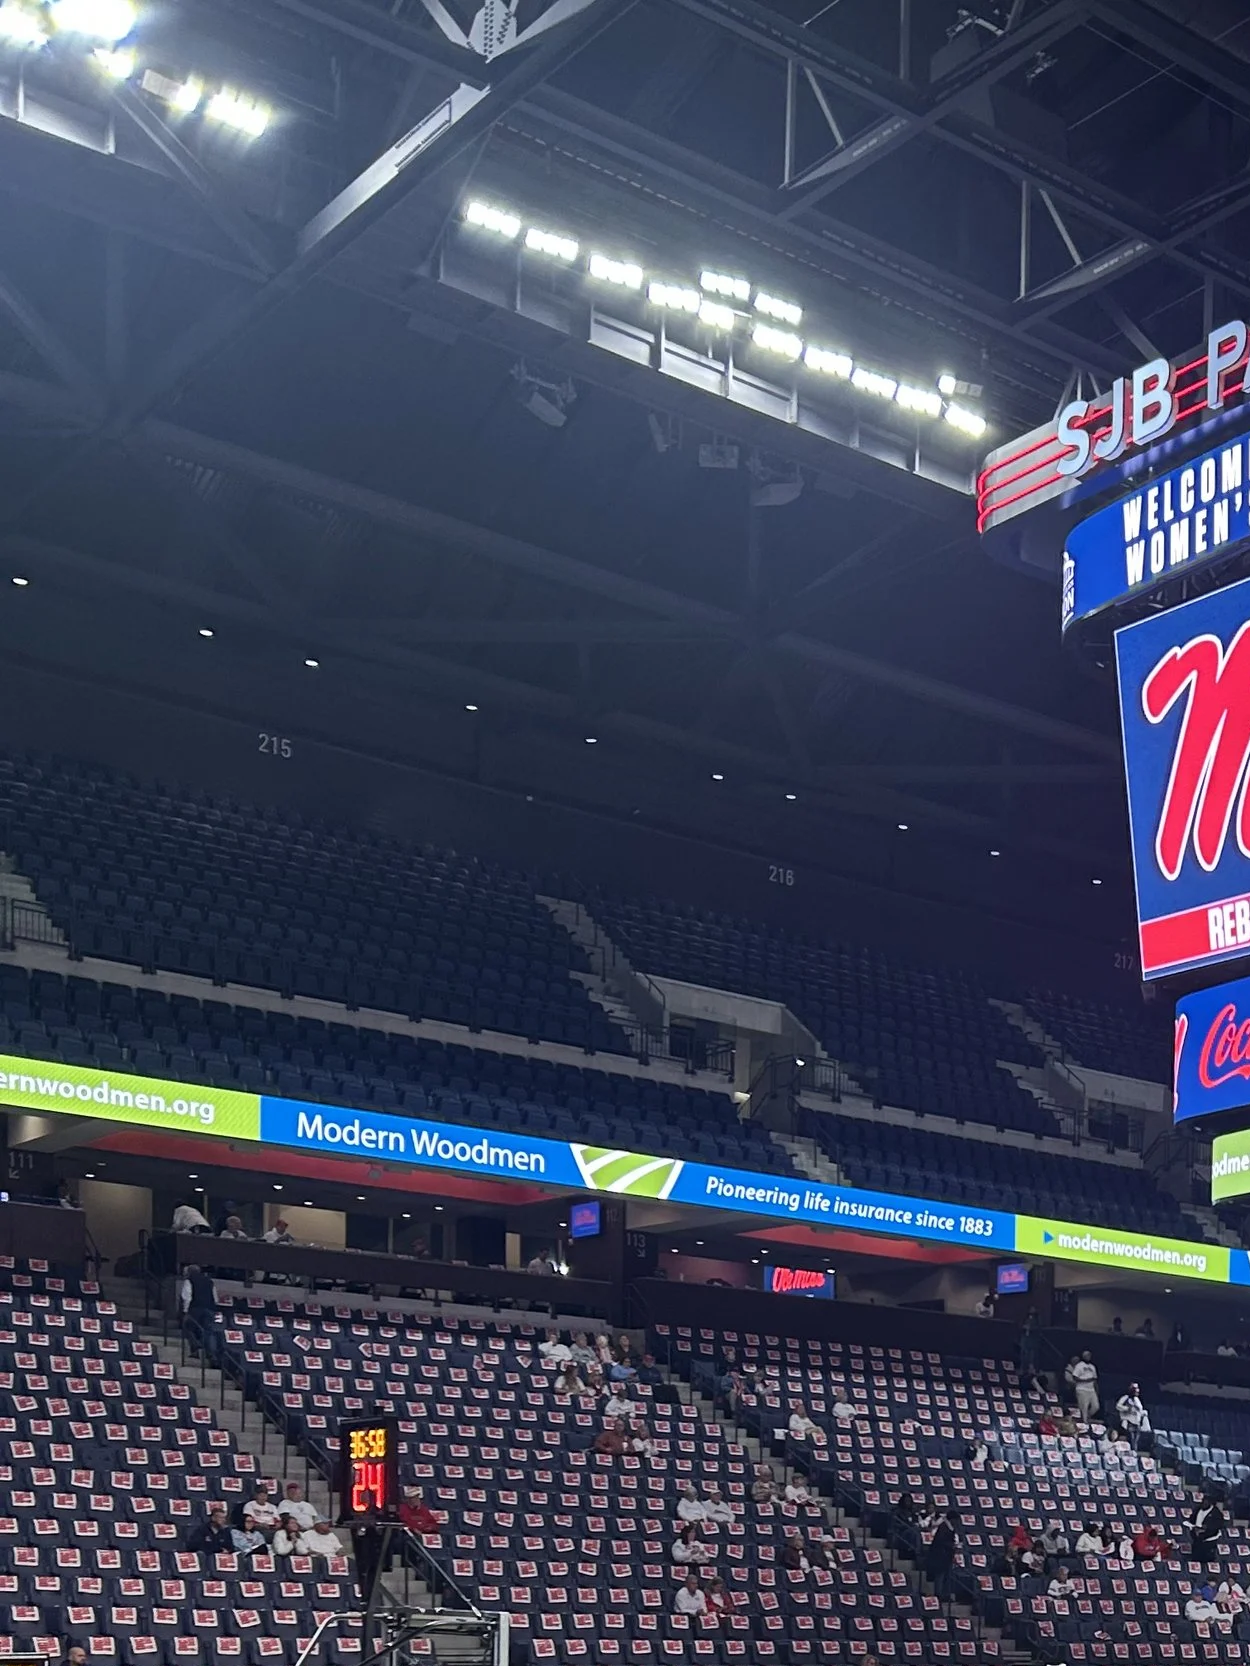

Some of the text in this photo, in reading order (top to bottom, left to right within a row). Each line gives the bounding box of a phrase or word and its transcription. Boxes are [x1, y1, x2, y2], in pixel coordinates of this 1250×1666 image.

[1056, 358, 1176, 476] SJB
[258, 733, 291, 758] 215
[297, 1111, 545, 1173] Modern Woodmen
[706, 1176, 993, 1236] Pioneering life insurance since 1883
[626, 1232, 646, 1247] 113
[1058, 1231, 1207, 1272] modernwoodmen.org
[350, 1428, 386, 1459] 36:58
[353, 1462, 385, 1511] 24
